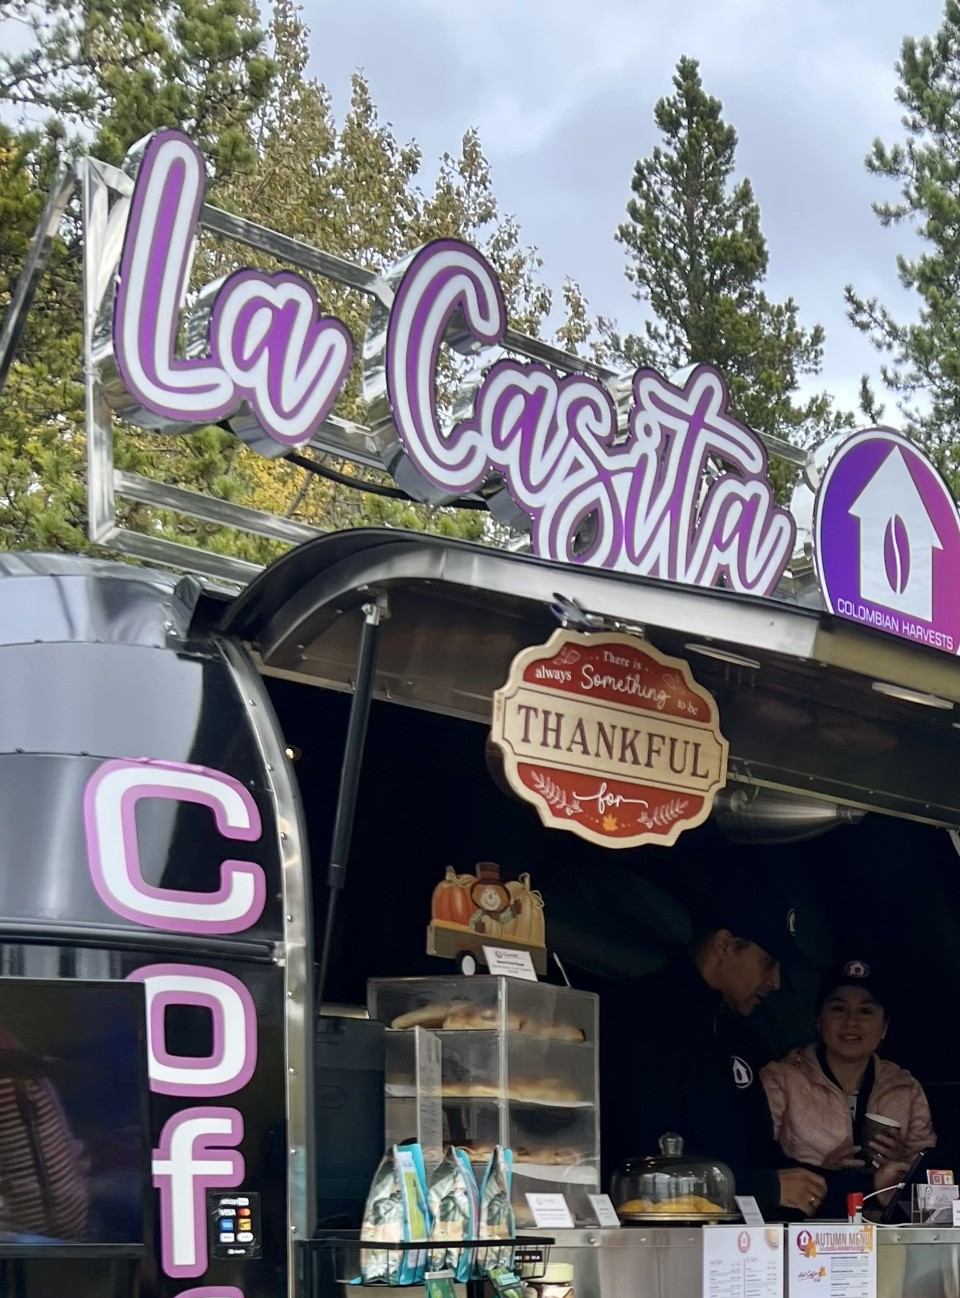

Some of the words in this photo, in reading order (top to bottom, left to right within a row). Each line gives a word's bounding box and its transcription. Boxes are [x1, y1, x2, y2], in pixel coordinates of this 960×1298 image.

[114, 127, 354, 446] La
[386, 238, 796, 597] Casita
[837, 597, 900, 633] COLOMBIAN
[902, 620, 954, 650] HARVESTS
[602, 650, 630, 667] There
[632, 659, 643, 670] is
[535, 666, 572, 683] always
[580, 663, 672, 710] Something
[677, 698, 686, 710] to
[687, 703, 699, 716] be
[516, 703, 711, 780] THANKFUL
[572, 781, 649, 815] for
[815, 1231, 847, 1247] AUTUMN
